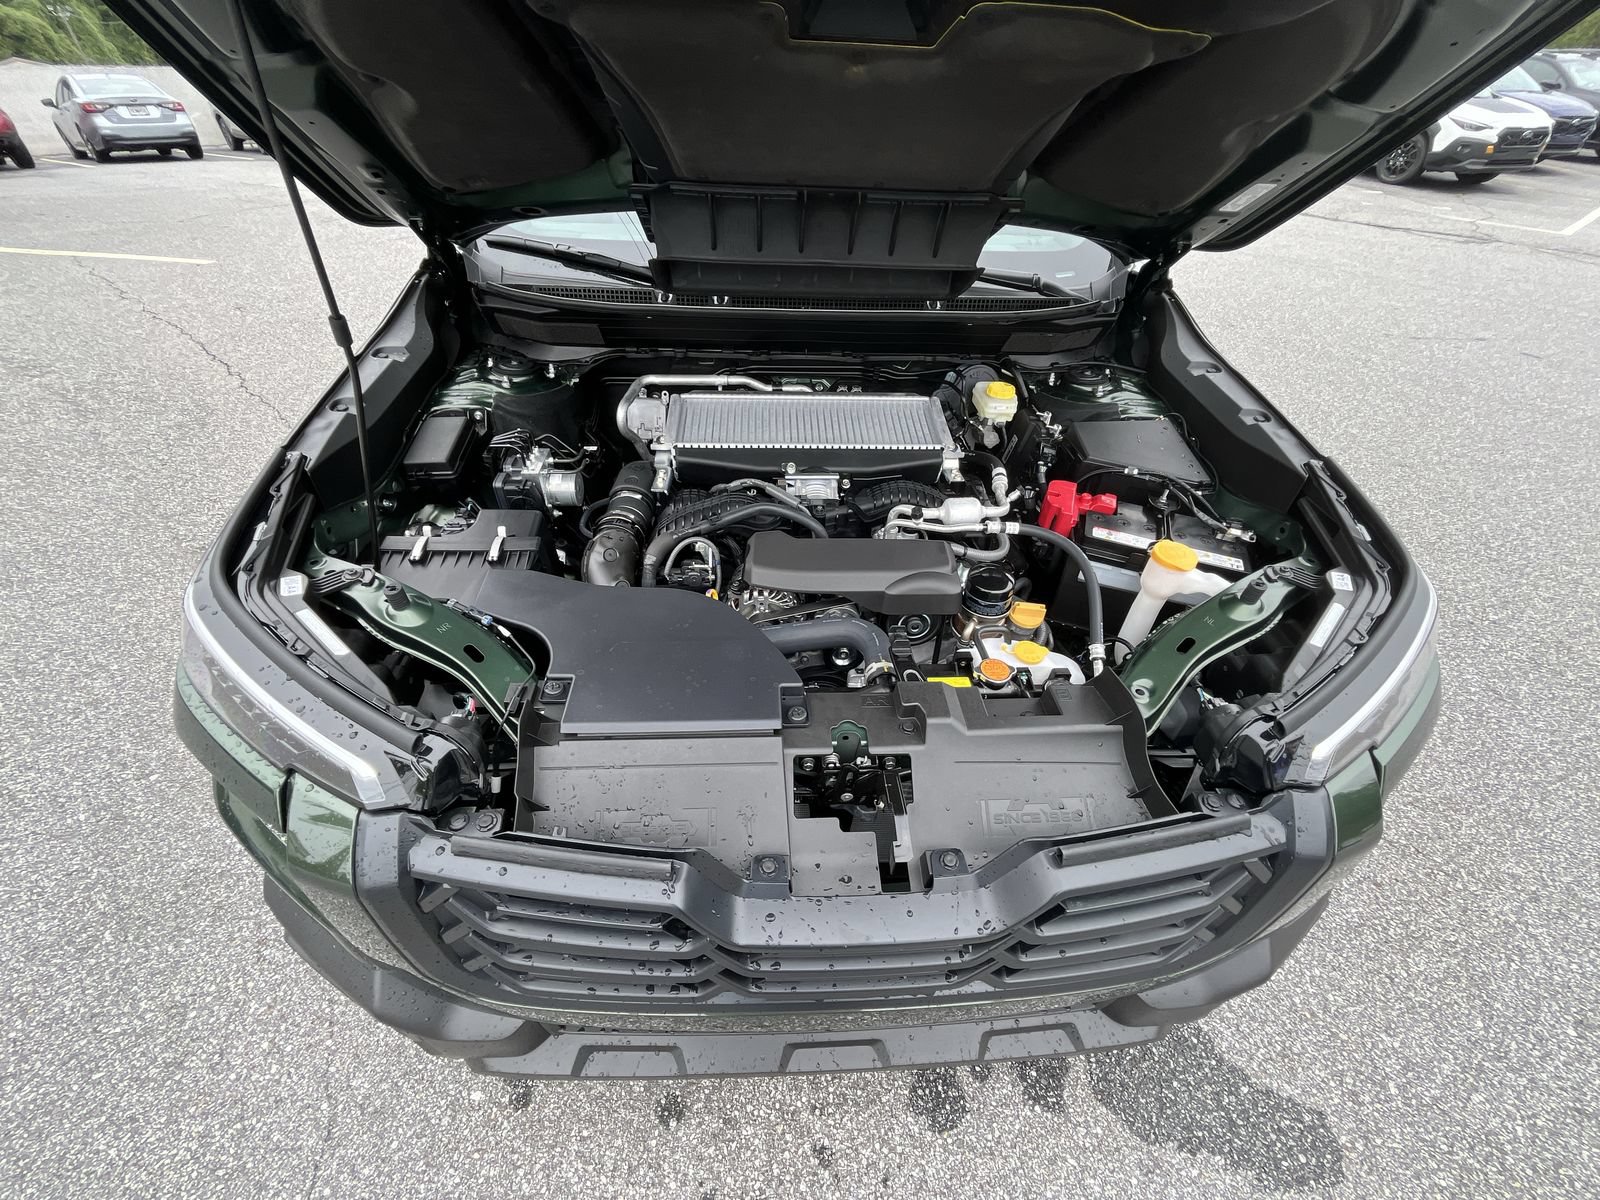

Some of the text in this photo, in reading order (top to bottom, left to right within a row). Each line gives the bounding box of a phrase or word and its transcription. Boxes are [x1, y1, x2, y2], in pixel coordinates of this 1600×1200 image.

[1203, 615, 1215, 627] NL
[436, 622, 453, 634] NR
[993, 812, 1041, 825] SINCE
